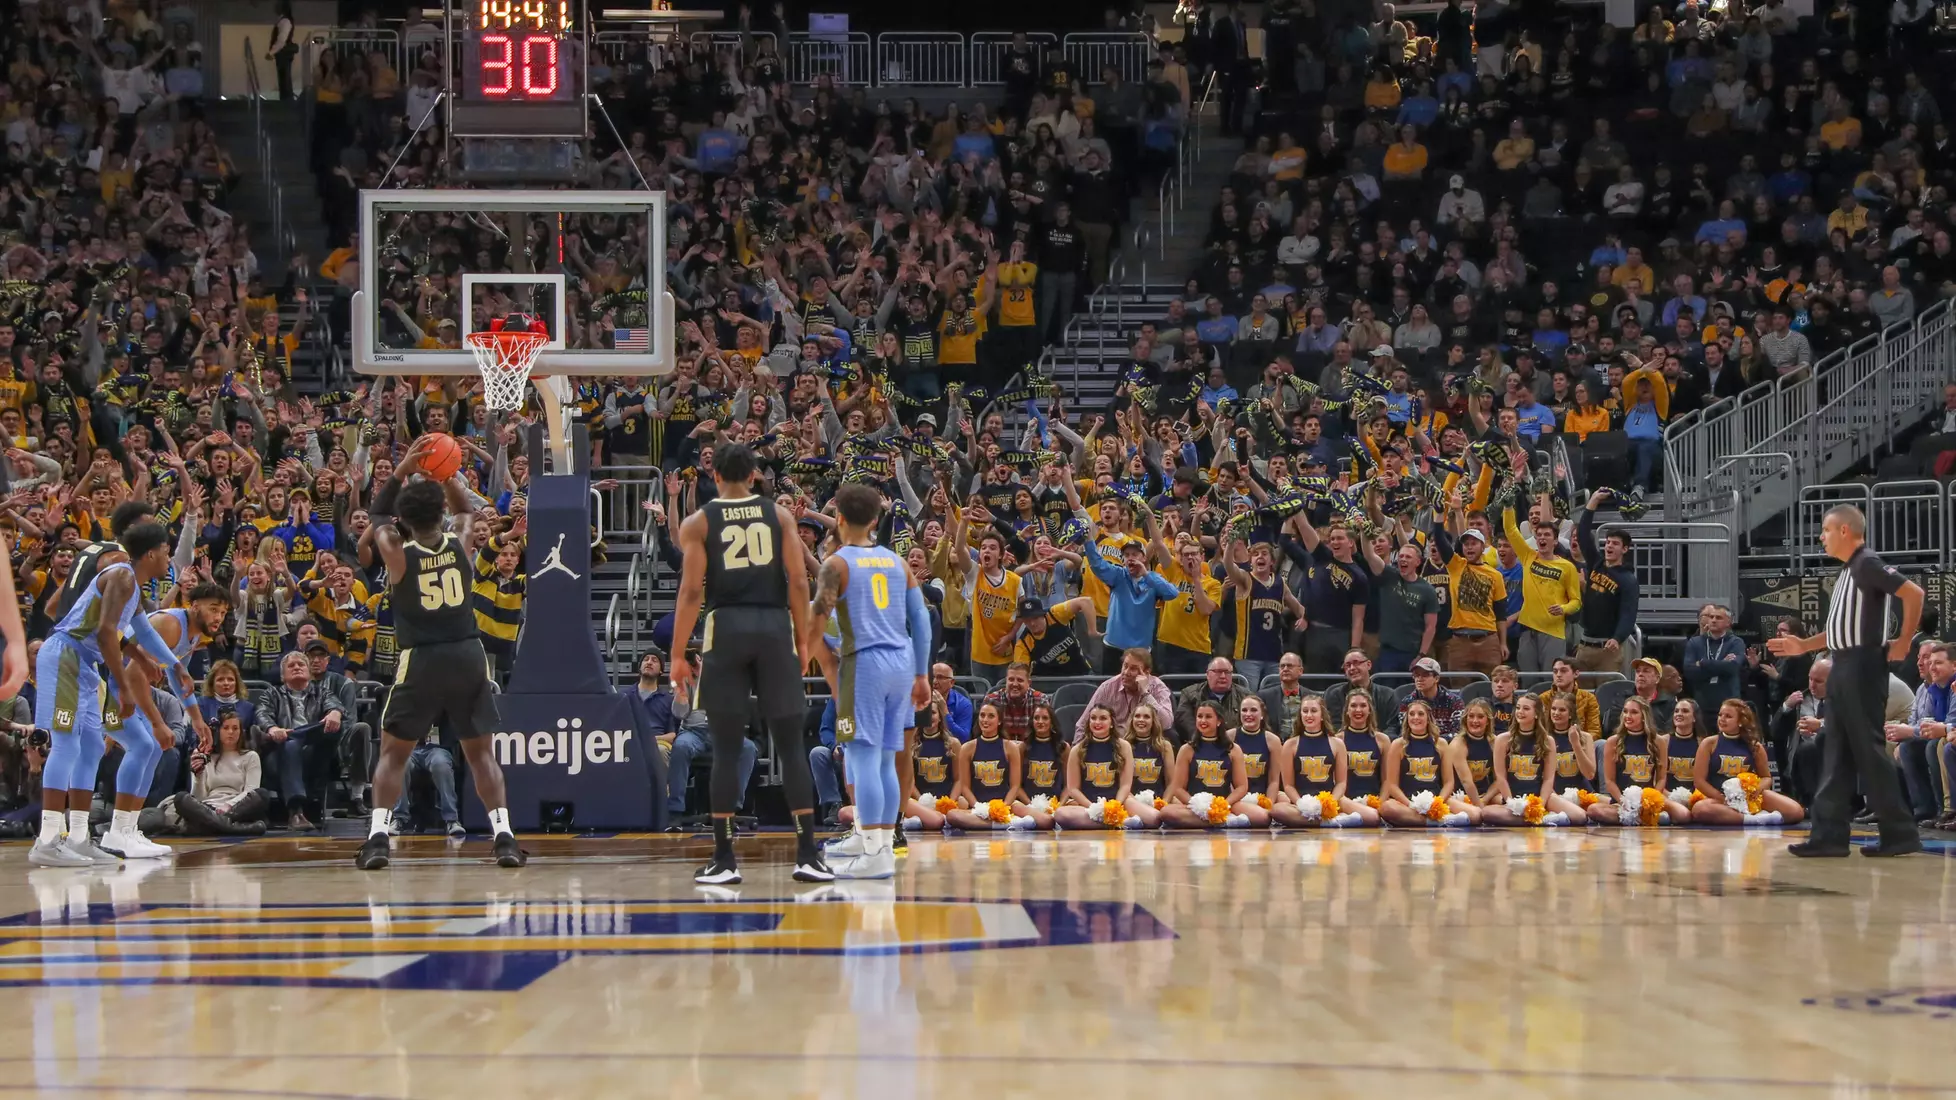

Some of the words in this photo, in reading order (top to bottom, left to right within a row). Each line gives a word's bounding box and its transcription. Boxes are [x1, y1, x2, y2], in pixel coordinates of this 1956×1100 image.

[481, 0, 567, 28] 14:41
[482, 36, 557, 95] 30
[374, 354, 404, 362] SPALDING
[624, 418, 636, 435] 3
[721, 505, 763, 521] EASTERN
[988, 496, 1013, 505] MARQUE
[292, 535, 314, 553] 33
[721, 522, 773, 570] 20
[1100, 544, 1124, 562] MARQUE
[69, 555, 88, 589] 1
[419, 551, 456, 571] WILLIAMS
[418, 567, 464, 611] 50
[871, 573, 889, 609] 0
[1436, 587, 1447, 605] 3
[1184, 598, 1195, 614] 3
[1262, 612, 1274, 630] 3
[56, 708, 74, 727] MU
[105, 711, 119, 726] MU
[838, 717, 854, 735] MU
[491, 717, 632, 775] meijer
[918, 756, 949, 783] MU
[973, 760, 1005, 787] MU
[1027, 760, 1058, 787] MU
[1085, 761, 1117, 788] MU
[1133, 758, 1161, 784] MU
[1196, 759, 1229, 788] MU
[1299, 755, 1333, 783] MU
[1349, 750, 1378, 777] MU
[1406, 756, 1439, 783] MU
[1508, 754, 1540, 781] MU
[1623, 754, 1655, 783] MU
